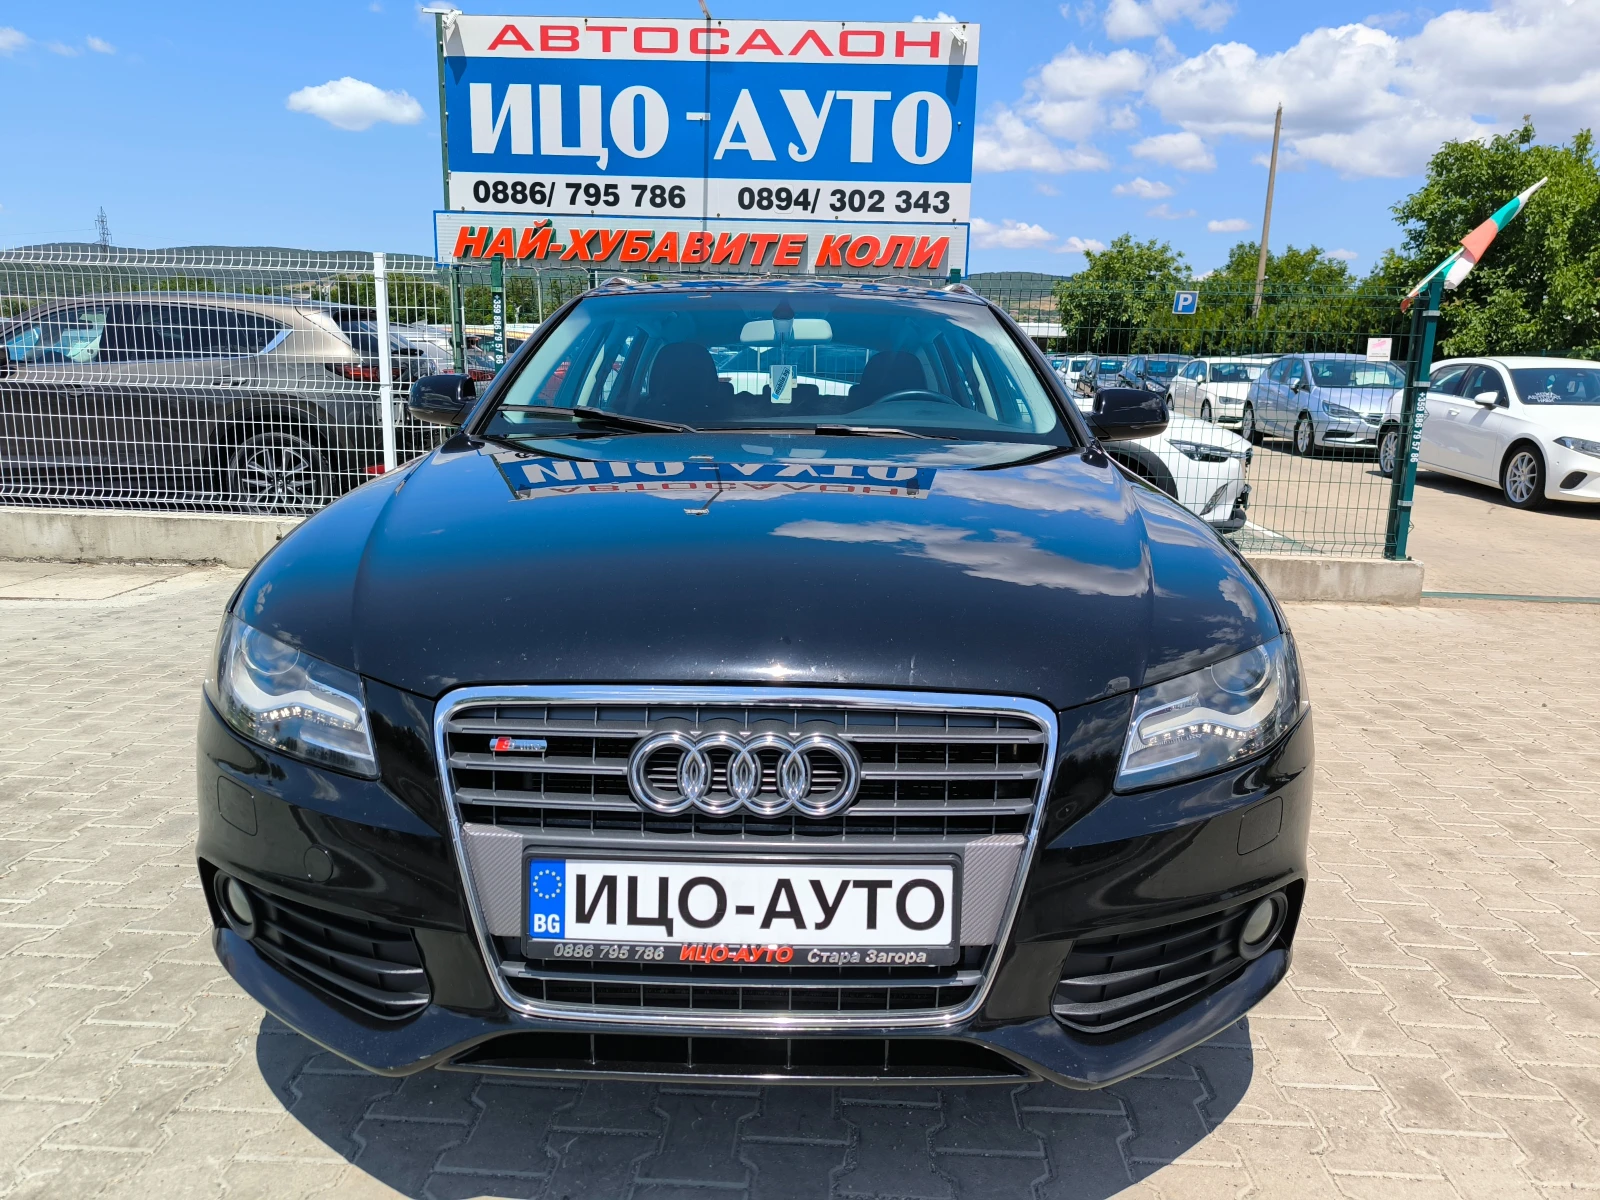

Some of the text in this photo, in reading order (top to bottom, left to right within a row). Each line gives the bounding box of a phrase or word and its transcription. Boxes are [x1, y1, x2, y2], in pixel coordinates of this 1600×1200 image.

[487, 24, 940, 58] АВТОСАЛОН
[473, 180, 686, 209] 0886/ 795 786
[738, 187, 950, 214] 0894/ 302 343
[453, 218, 950, 270] НАЙ-ХУБАВИТЕ КОЛИ
[1177, 293, 1193, 312] P
[493, 294, 504, 365] +359 886 79 57 86
[1409, 391, 1426, 463] +359 886 79 57 86
[575, 873, 945, 937] ИЦО-АУТО
[533, 913, 560, 934] BG
[553, 943, 665, 960] 0886 795 786
[679, 943, 794, 964] ИЦО-АУТО
[807, 948, 927, 965] Стара Загора
